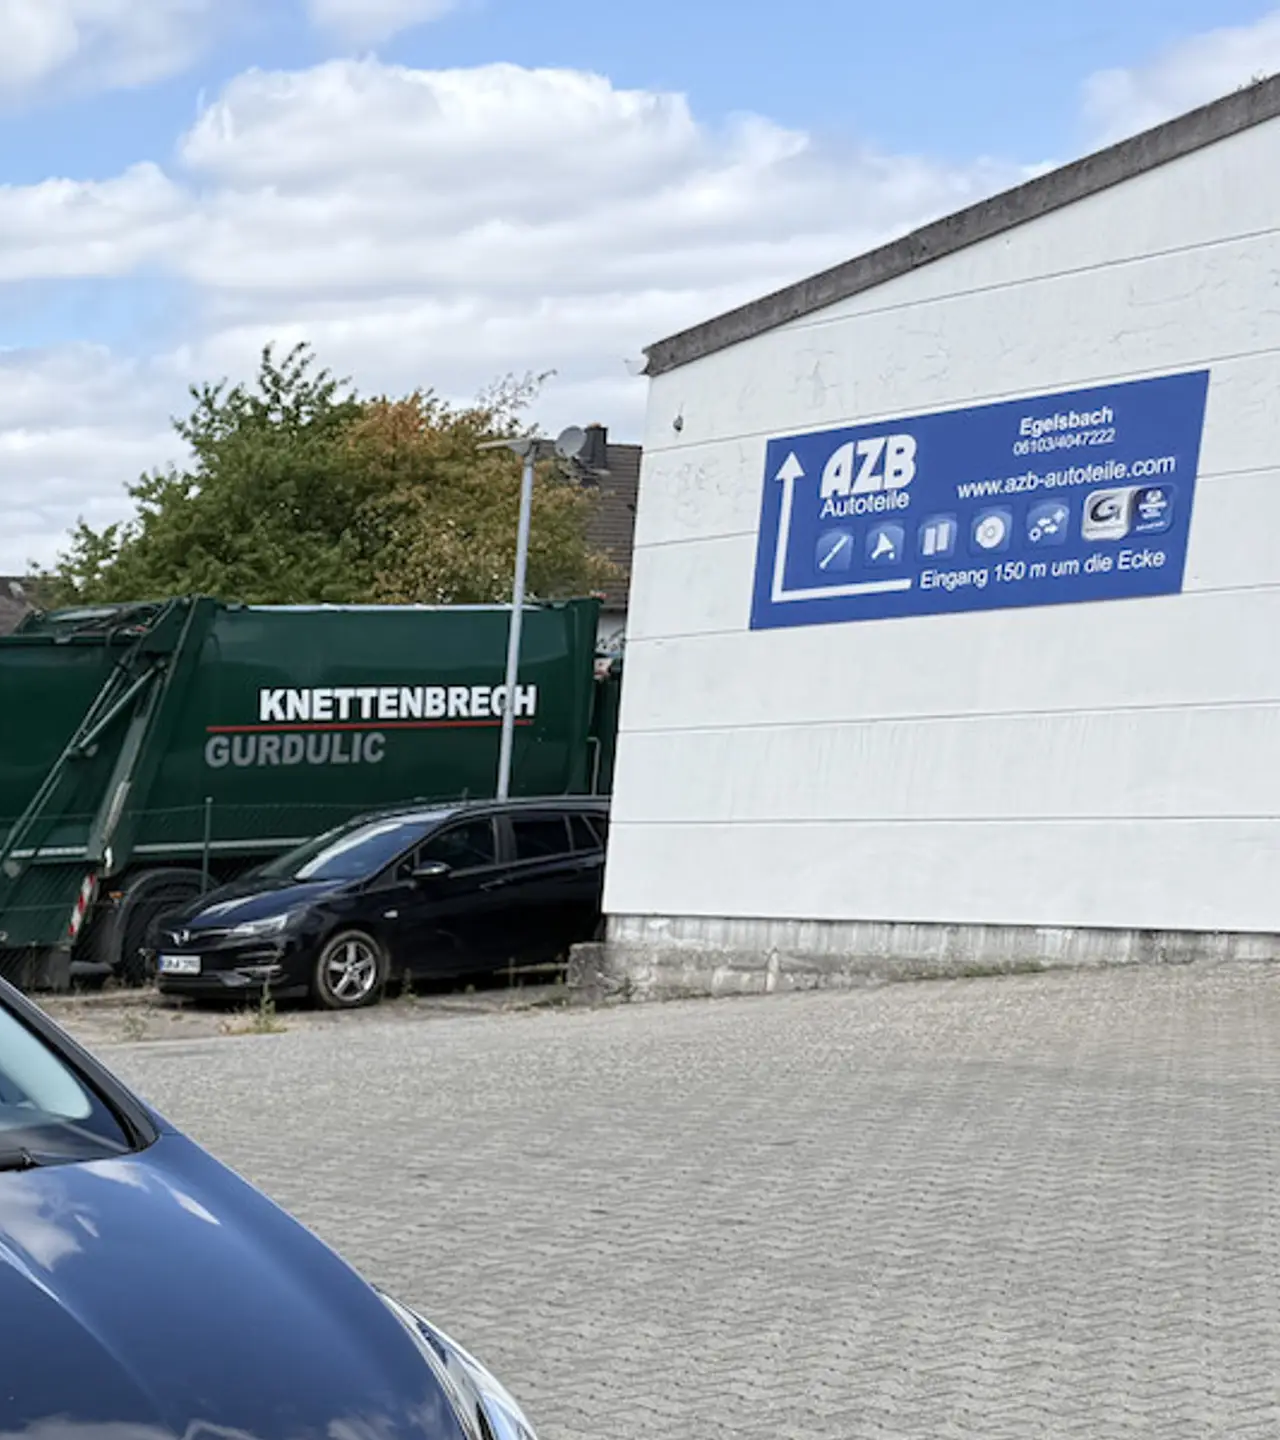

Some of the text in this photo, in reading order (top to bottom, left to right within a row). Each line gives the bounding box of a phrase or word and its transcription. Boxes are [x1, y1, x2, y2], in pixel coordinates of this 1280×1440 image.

[1019, 406, 1113, 437] Egelsbach
[820, 434, 917, 498] AZB
[956, 455, 1176, 501] www.azb-autoteile.com
[820, 490, 910, 519] Autoteile
[920, 549, 1165, 591] Eingang 150 m um die Ecke
[205, 732, 386, 767] GURDULIC
